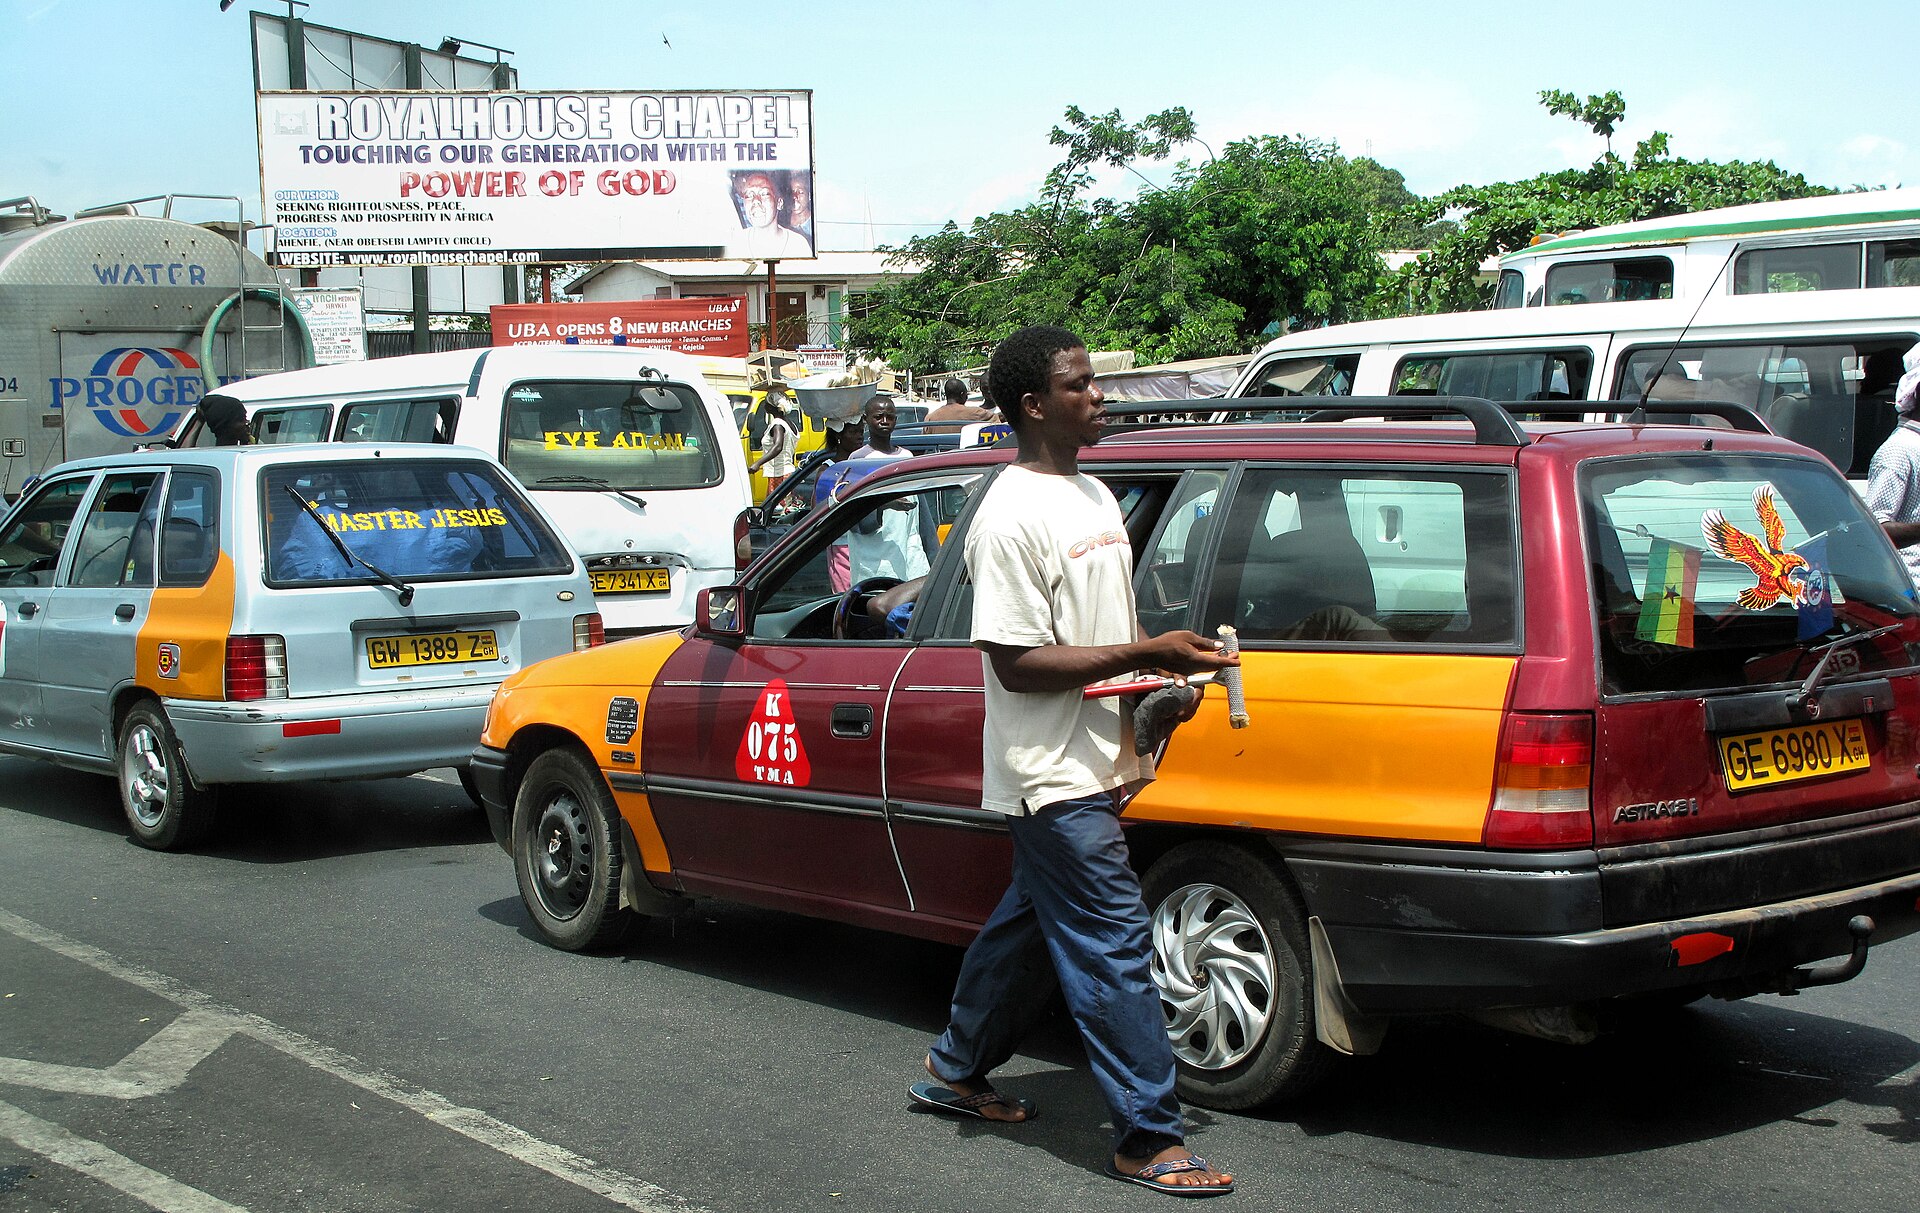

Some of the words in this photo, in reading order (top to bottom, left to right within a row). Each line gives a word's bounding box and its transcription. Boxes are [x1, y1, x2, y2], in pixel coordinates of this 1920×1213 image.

[317, 95, 612, 140] ROYALHOUSE
[630, 95, 798, 139] CHAPEL
[299, 144, 431, 164] TOUCHING
[439, 144, 493, 164] OUR
[501, 143, 658, 164] GENERATION
[666, 143, 727, 162] WITH
[734, 142, 777, 162] THE
[400, 170, 527, 198] POWER
[538, 169, 585, 197] OF
[597, 169, 677, 196] GOD
[275, 190, 299, 200] OUR
[300, 190, 340, 200] VISION:
[276, 202, 325, 211] SEEKING
[328, 201, 424, 212] RIGHTEOUSNESS,
[427, 201, 466, 211] PEACE,
[276, 213, 338, 223] PROGRESS
[341, 213, 364, 223] AND
[367, 212, 437, 223] PROSPERITY
[440, 212, 452, 222] IN
[455, 212, 495, 222] AFRICA
[277, 227, 338, 238] LOCATION:
[324, 238, 354, 248] (NEAR
[357, 237, 404, 247] OBETSEBI
[407, 236, 450, 246] LAMPTEY
[453, 236, 493, 247] CIRCLE)
[280, 252, 345, 265] WEBSITE:
[349, 251, 541, 265] www.royalhousechapel.com
[708, 304, 730, 313] UBA
[508, 323, 551, 338] UBA
[556, 323, 605, 337] OPENS
[608, 316, 623, 335] 8
[626, 323, 658, 335] NEW
[662, 318, 733, 334] BRANCHES
[631, 336, 673, 344] Kantamanto
[682, 343, 705, 351] Kejetia
[319, 510, 427, 532] MASTER
[430, 507, 508, 528] JESUS
[608, 572, 642, 590] 7341
[645, 571, 657, 589] X
[371, 640, 400, 663] GW
[410, 636, 459, 662] 1389
[467, 634, 483, 657] Z
[483, 647, 494, 656] GH
[765, 692, 782, 717] K
[747, 721, 798, 762] 075
[1726, 737, 1770, 782] GE
[1771, 730, 1832, 775] 6980
[1831, 723, 1854, 766] X
[1852, 745, 1865, 761] GH
[753, 764, 795, 785] TMA
[1612, 800, 1670, 825] ASTRA
